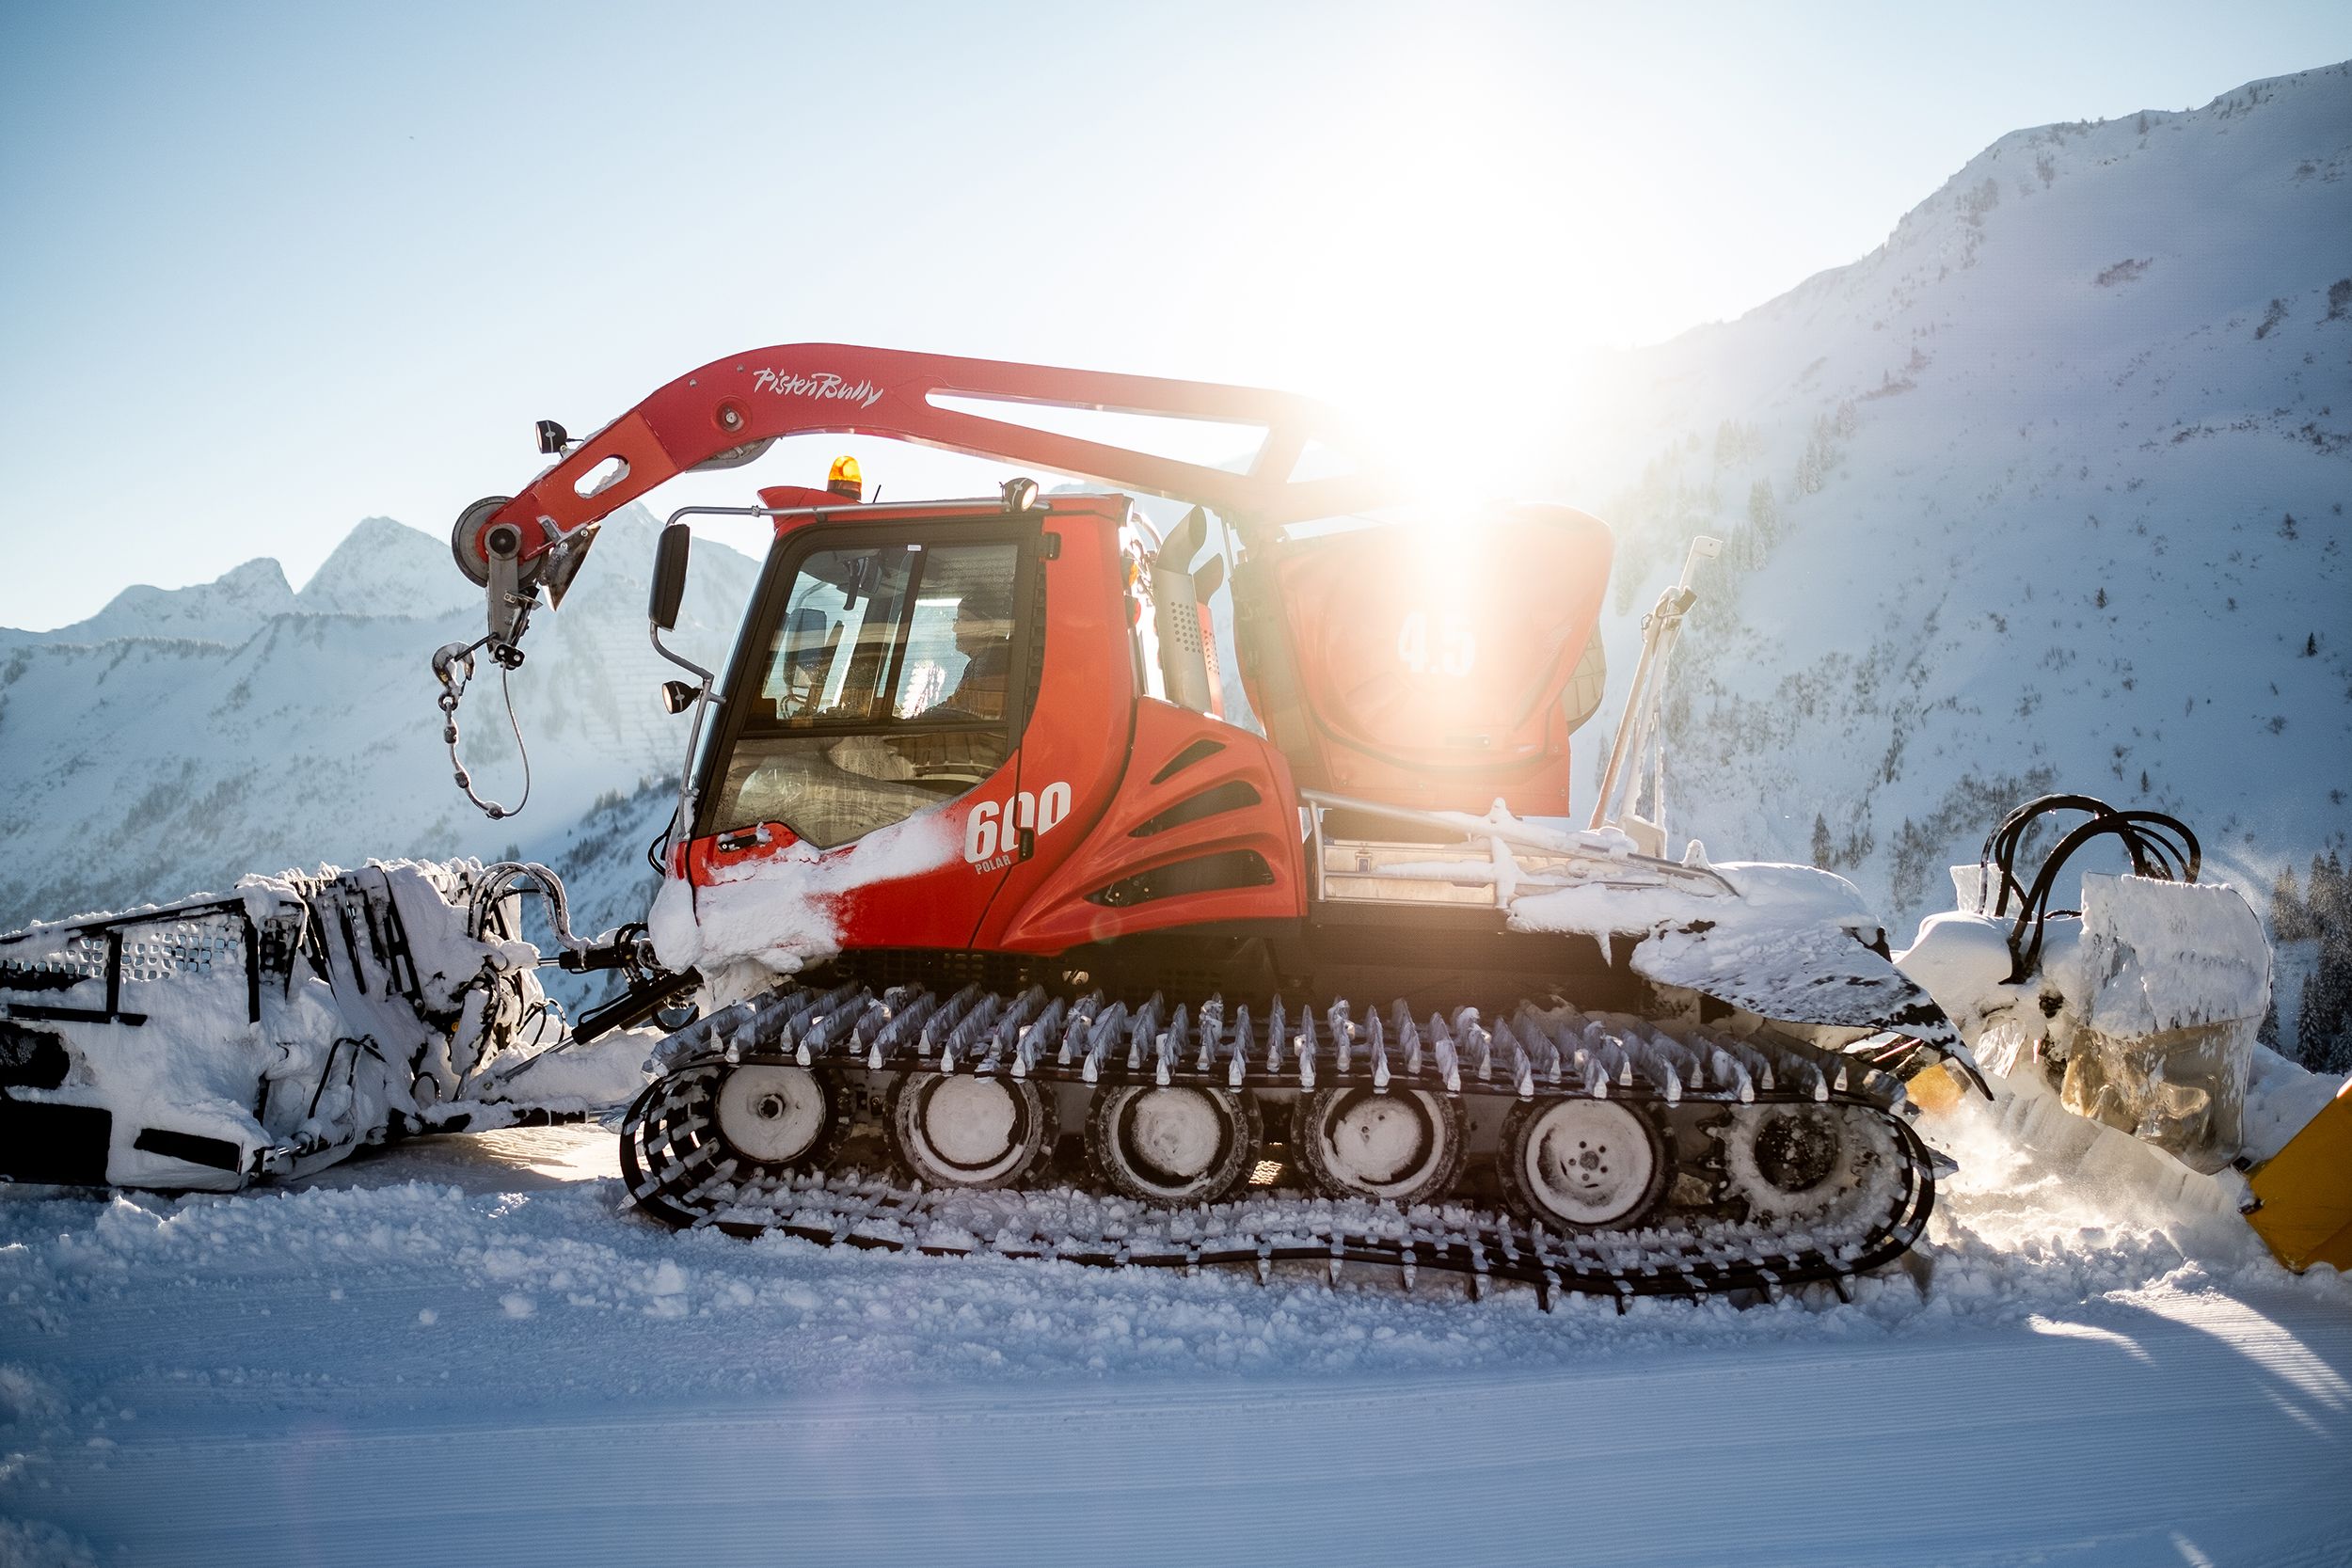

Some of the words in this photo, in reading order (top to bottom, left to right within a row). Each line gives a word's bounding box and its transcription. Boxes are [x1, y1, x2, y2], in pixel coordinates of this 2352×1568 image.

[754, 368, 883, 408] PistenBully
[1398, 611, 1475, 676] 4.5
[964, 782, 1072, 863] 600
[975, 855, 1011, 875] POLAR
